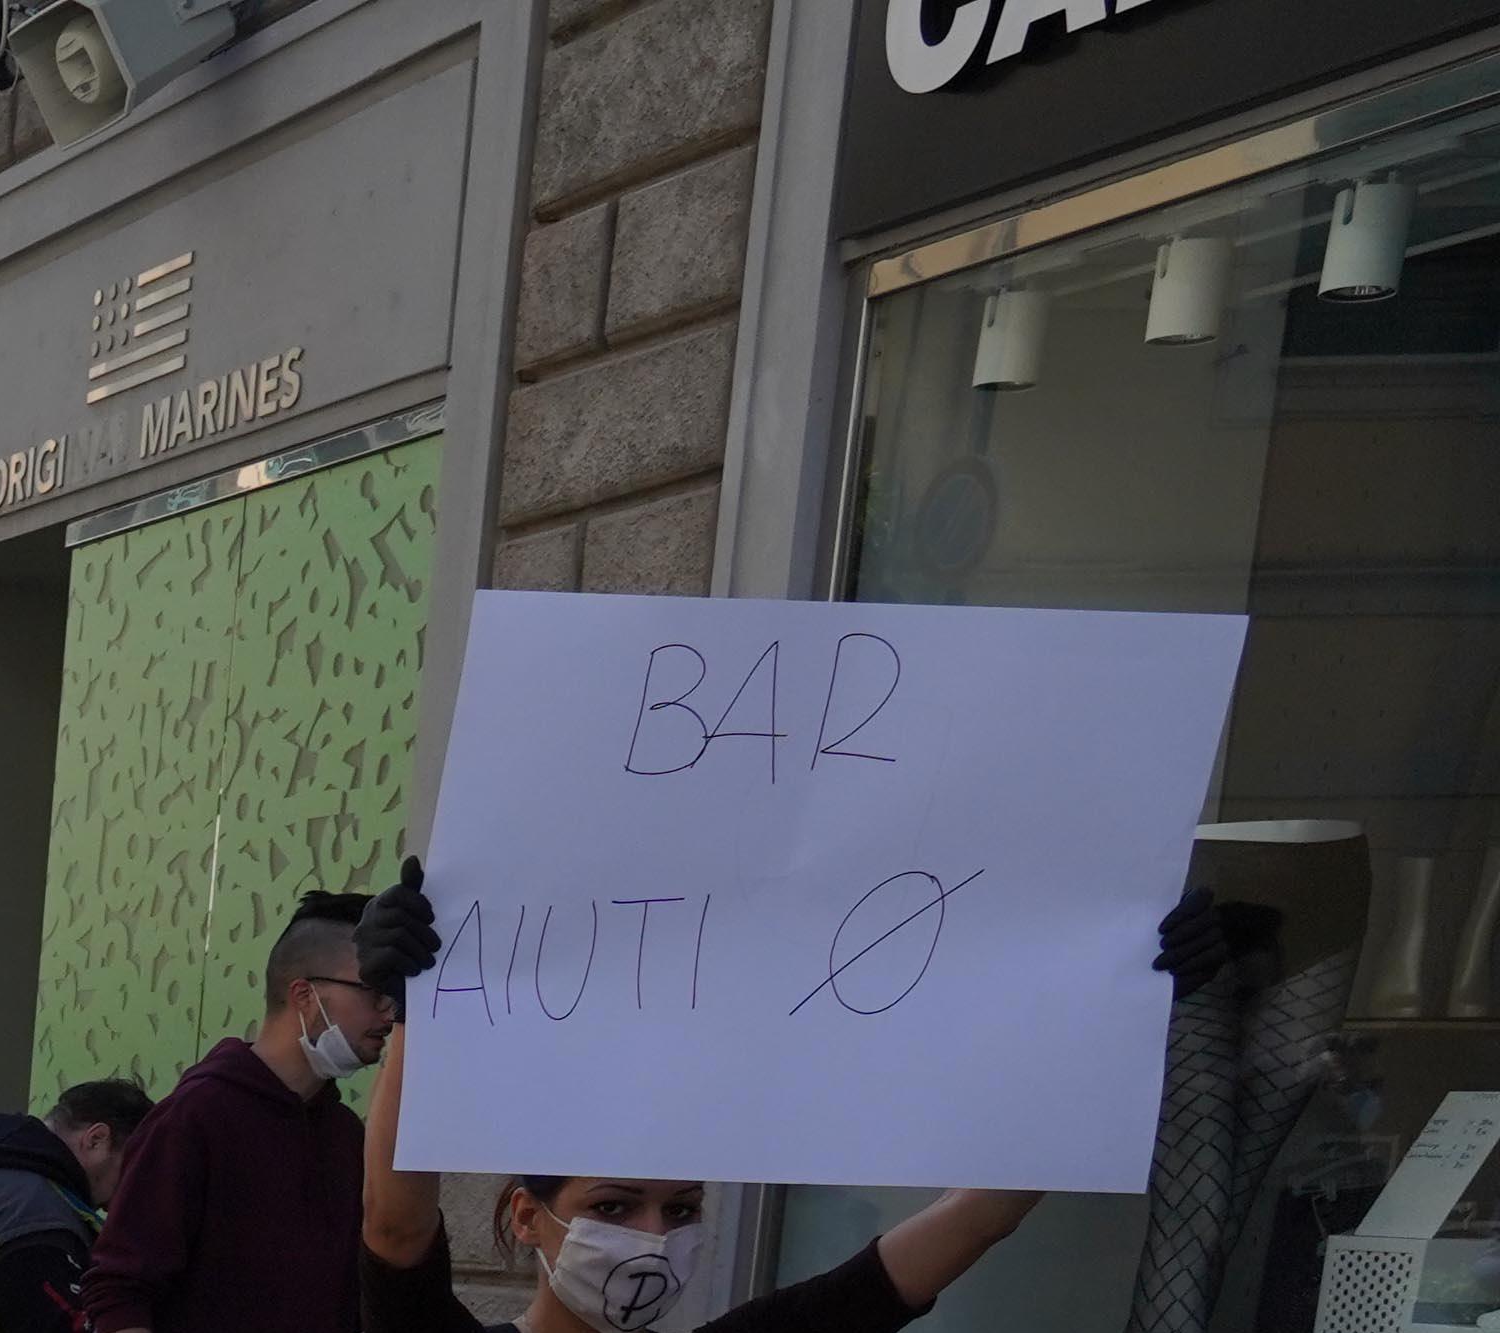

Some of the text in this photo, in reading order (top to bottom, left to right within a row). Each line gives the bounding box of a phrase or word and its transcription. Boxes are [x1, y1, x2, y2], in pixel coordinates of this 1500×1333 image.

[140, 346, 304, 459] MARINES
[624, 632, 902, 784] BAR
[432, 892, 711, 1027] AIUTI
